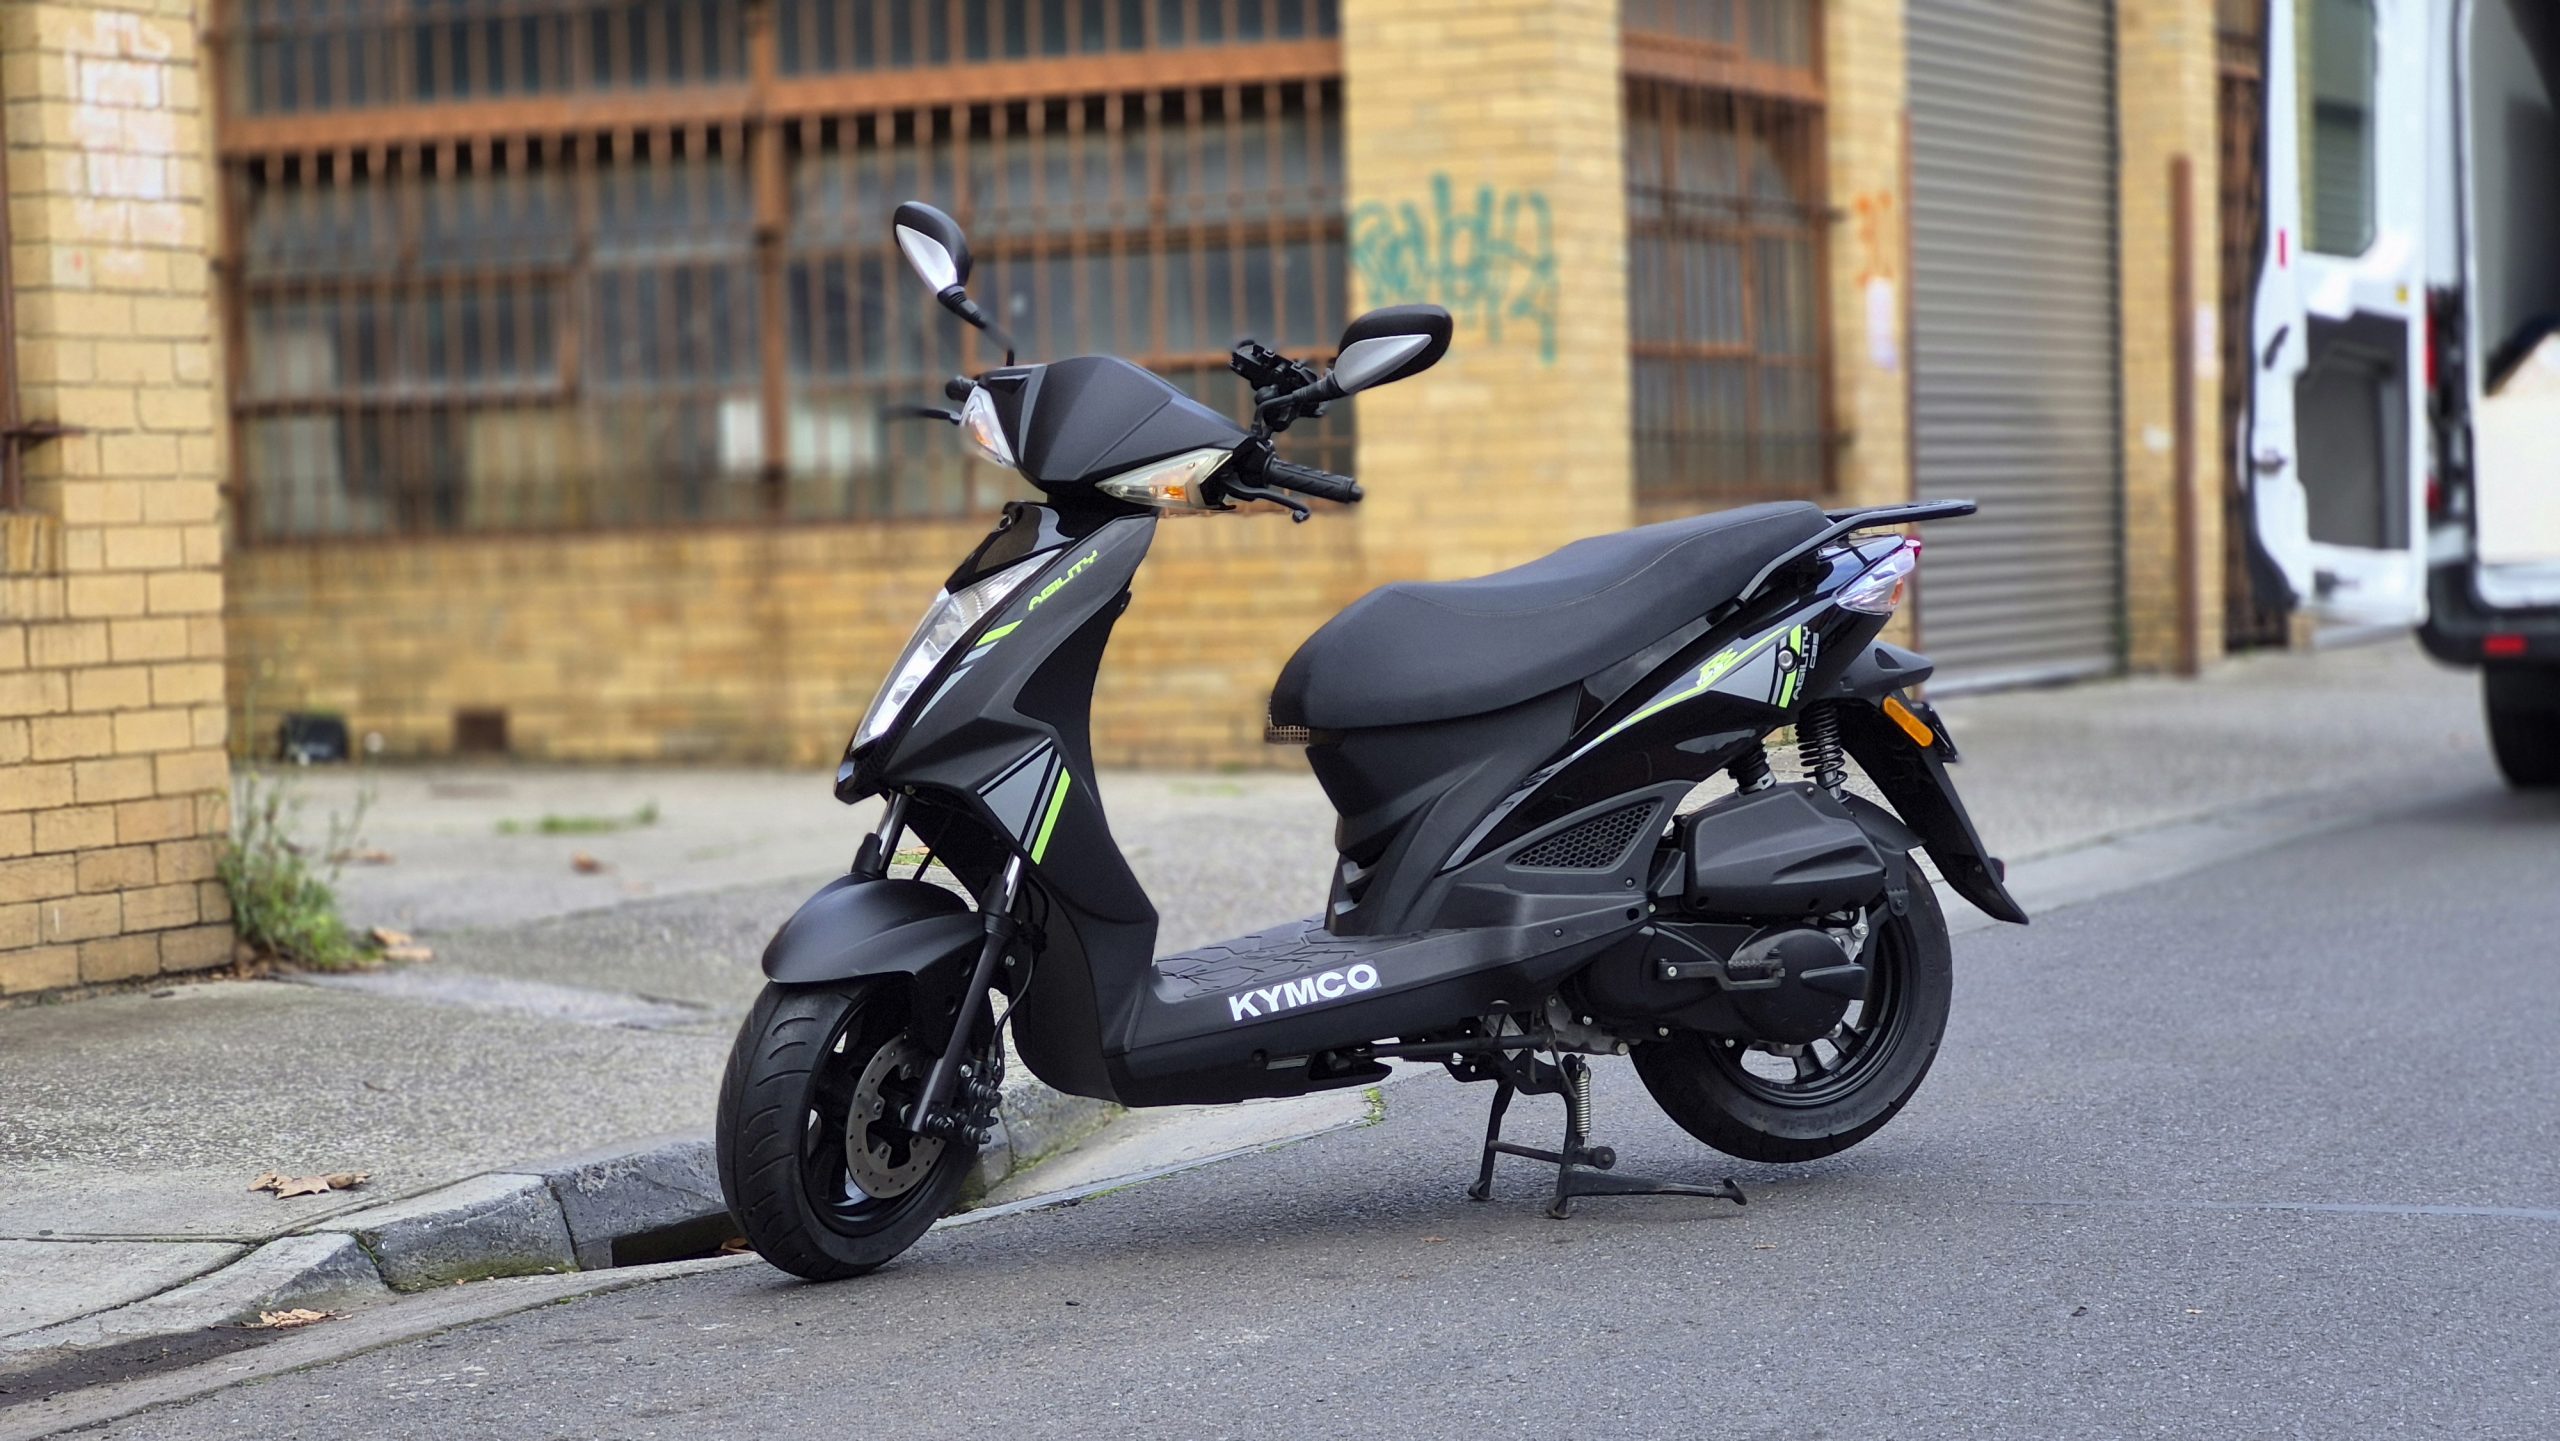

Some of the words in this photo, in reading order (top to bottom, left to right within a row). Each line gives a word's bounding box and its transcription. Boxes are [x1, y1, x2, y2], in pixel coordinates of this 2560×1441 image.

[1028, 550, 1098, 611] AGILITY
[1793, 626, 1811, 700] AGILITY
[1228, 963, 1378, 1022] KYMCO
